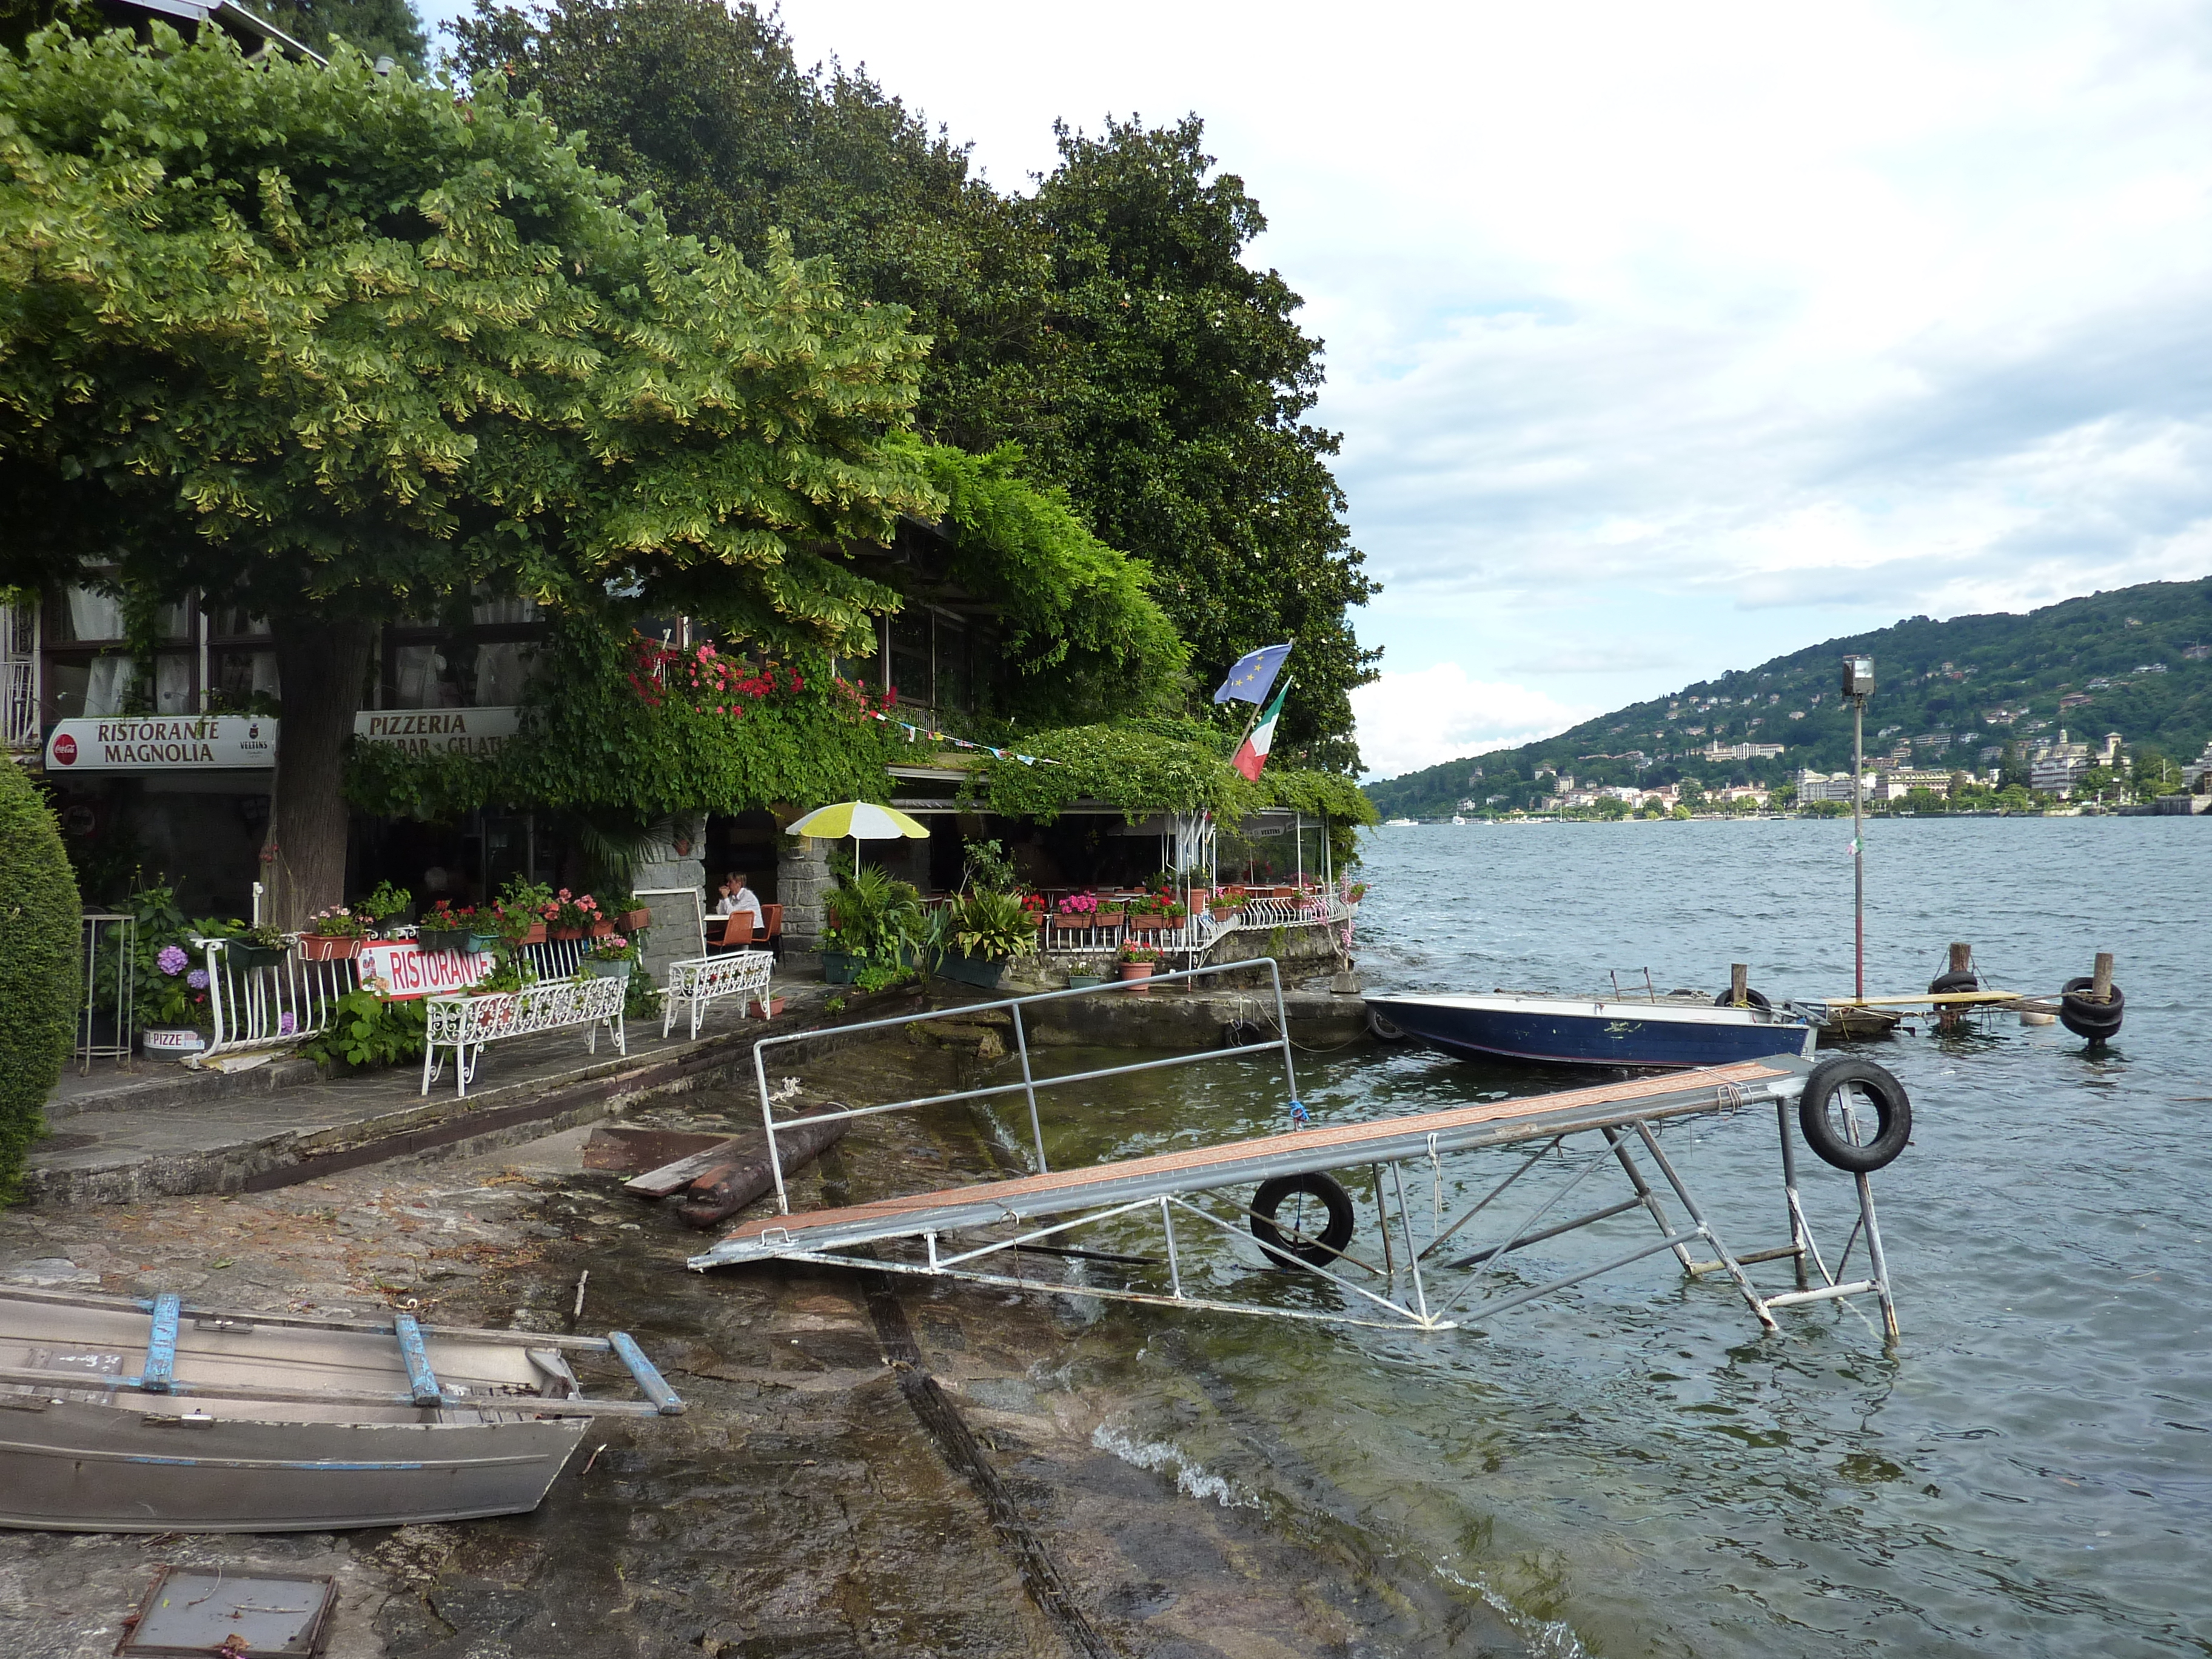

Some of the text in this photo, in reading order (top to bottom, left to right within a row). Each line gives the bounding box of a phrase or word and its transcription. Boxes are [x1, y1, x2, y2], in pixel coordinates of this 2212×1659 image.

[98, 722, 219, 742] RISTORANTE
[369, 714, 466, 736] PIZZERIA
[105, 743, 215, 763] MAGNOLIA
[240, 741, 268, 749] VELTINS
